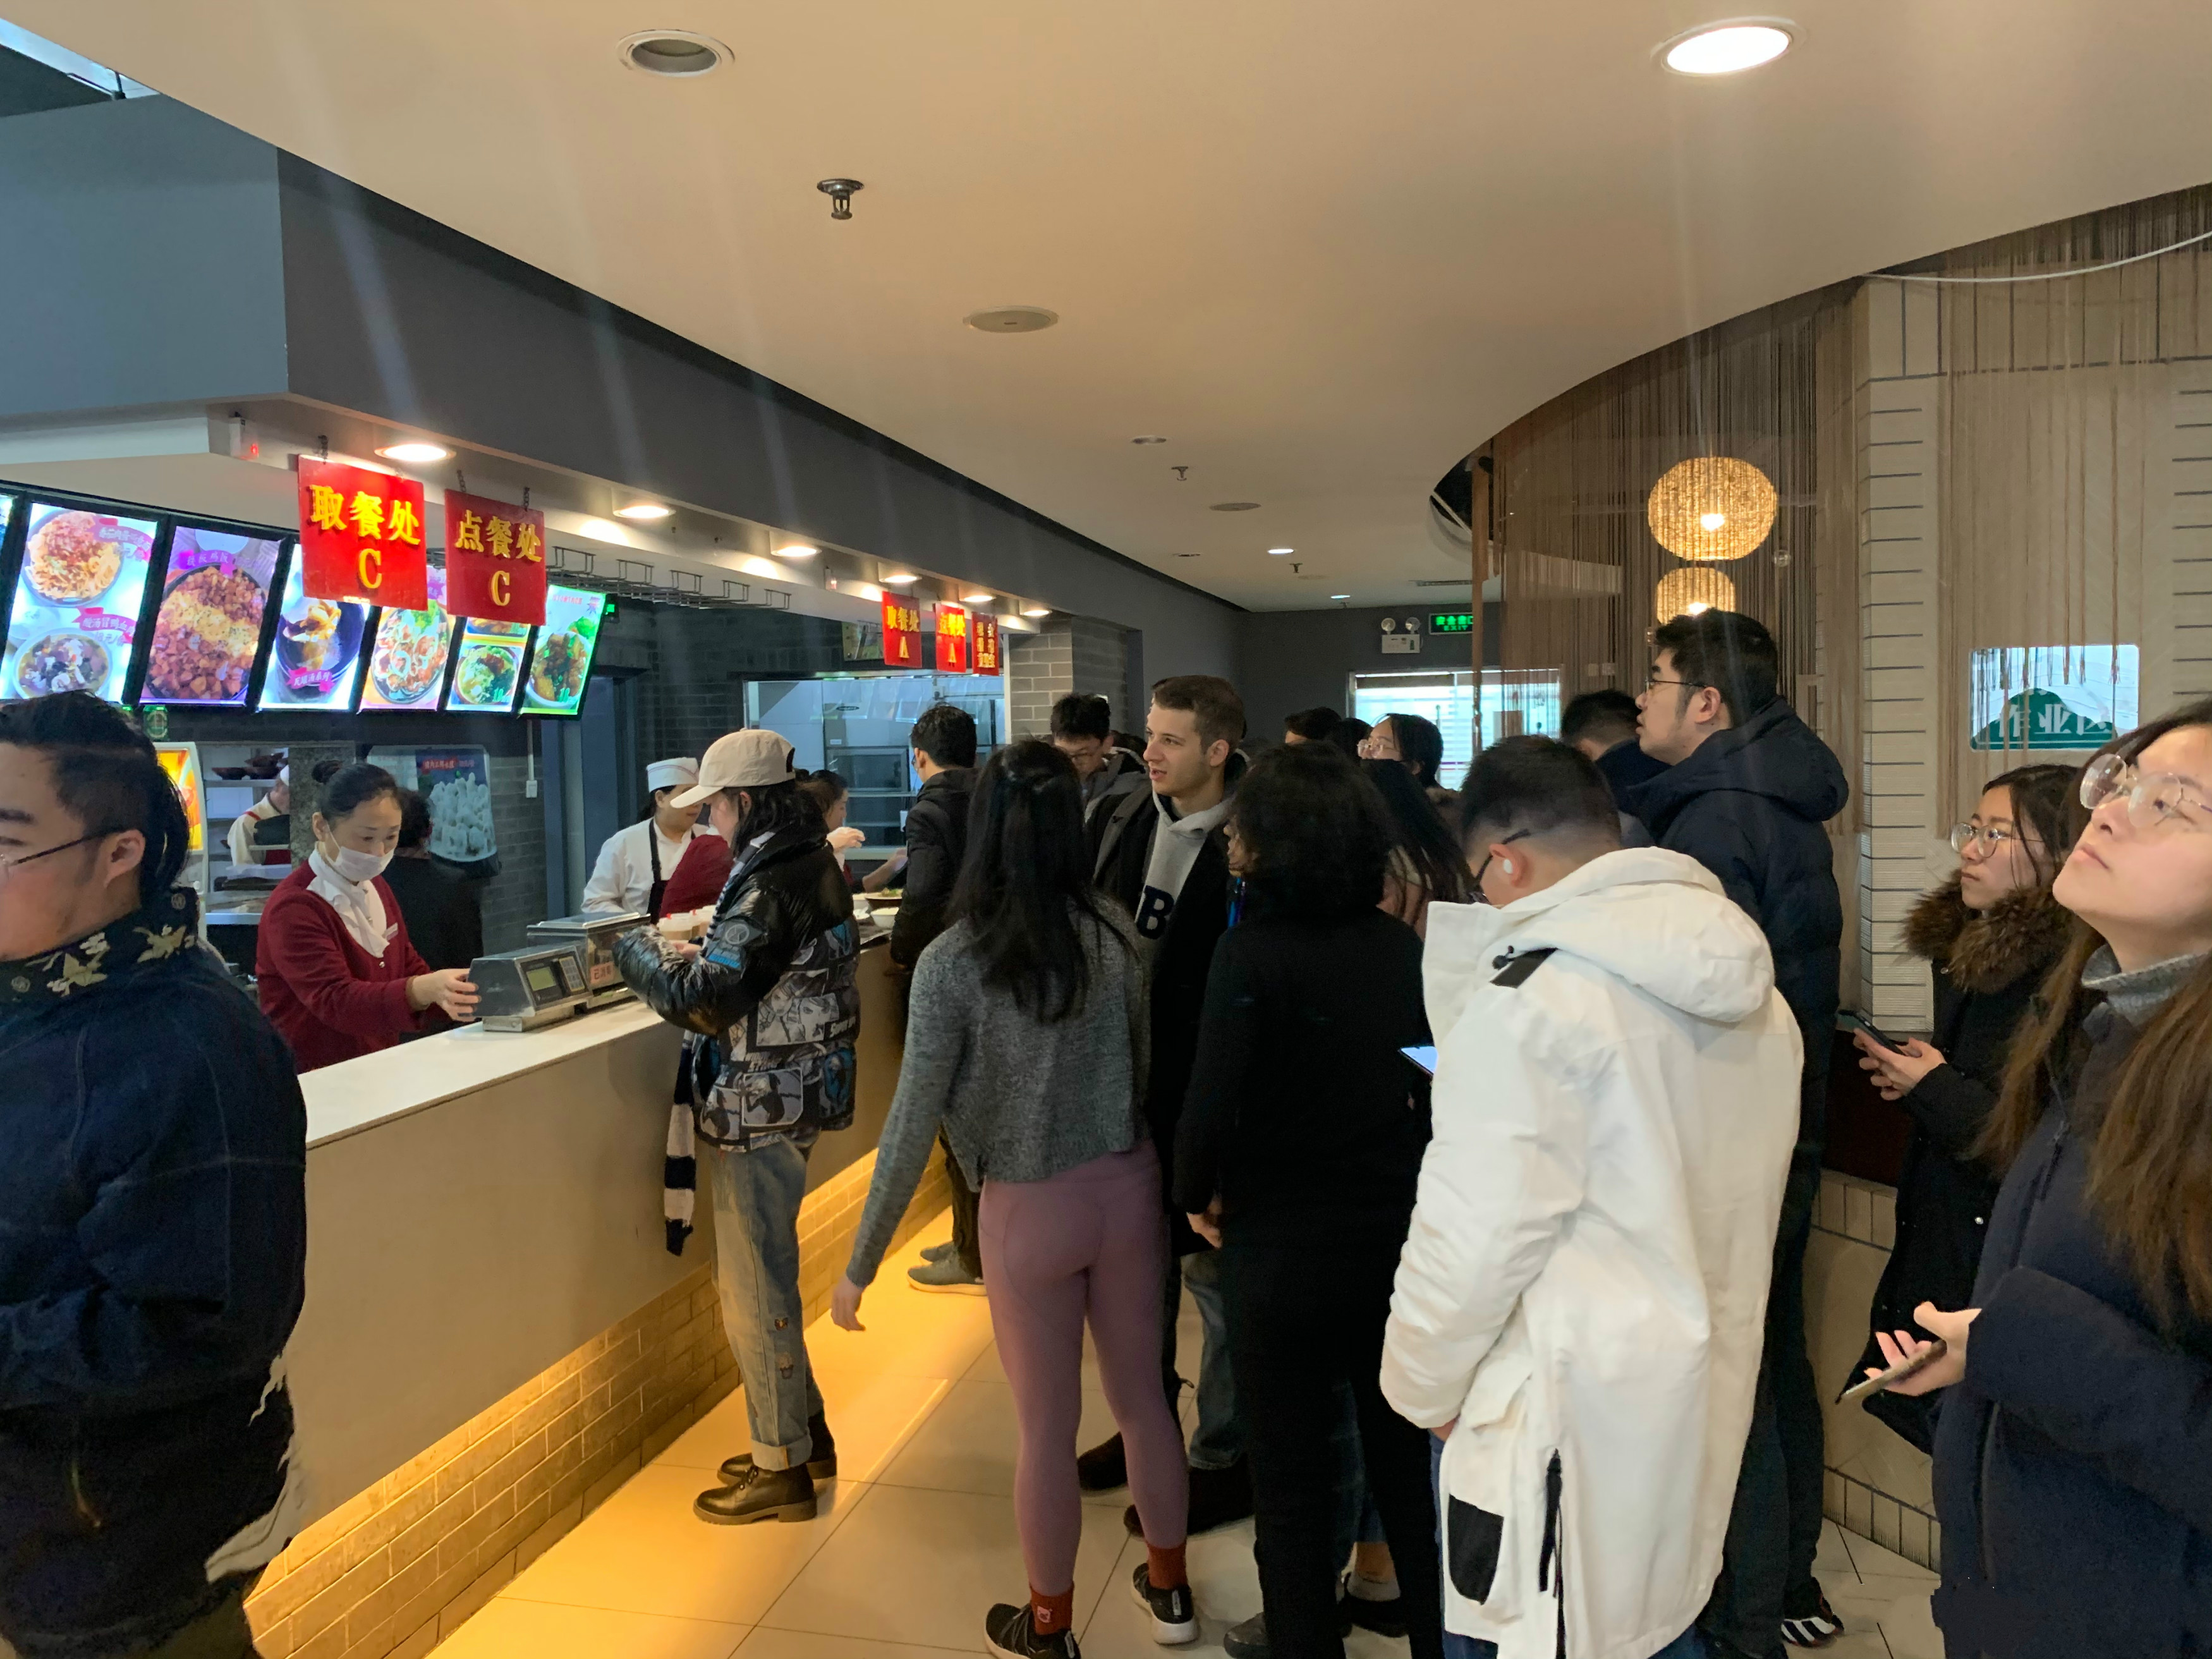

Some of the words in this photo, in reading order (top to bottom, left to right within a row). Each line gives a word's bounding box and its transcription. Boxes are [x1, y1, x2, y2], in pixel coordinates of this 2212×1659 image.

[309, 483, 422, 545] 取餐处
[454, 509, 543, 562] 点餐处
[358, 548, 382, 589] C
[490, 570, 511, 607] C
[886, 605, 920, 632] 取餐处
[898, 636, 909, 659] A
[947, 643, 957, 663] A
[1137, 885, 1175, 940] B
